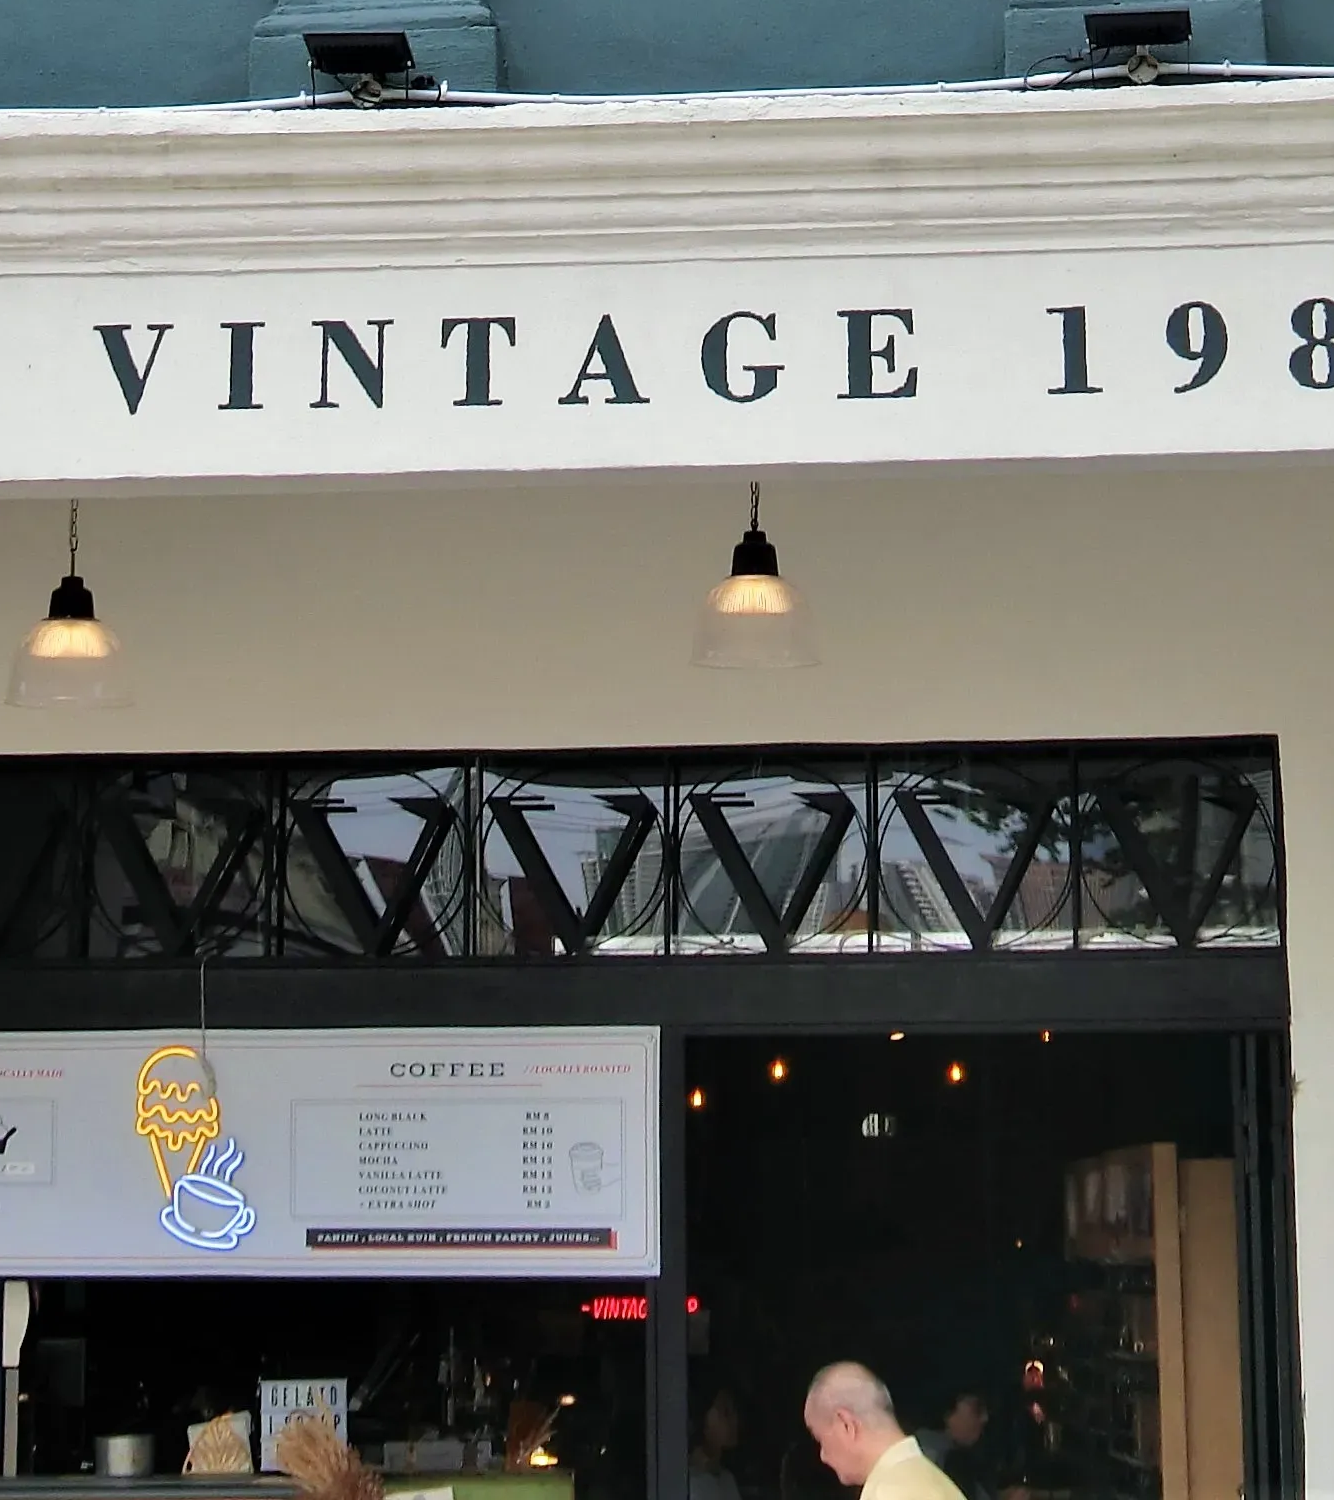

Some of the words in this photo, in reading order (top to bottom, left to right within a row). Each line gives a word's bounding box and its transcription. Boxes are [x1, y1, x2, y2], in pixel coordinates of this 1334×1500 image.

[94, 307, 920, 415] VINTAGE
[389, 1062, 506, 1078] COFFEE
[358, 1112, 389, 1121] LONG
[391, 1112, 428, 1121] BLACK
[358, 1127, 393, 1136] LATTE
[358, 1141, 429, 1151] CAPPUCCINO
[358, 1156, 398, 1165] MOCHA
[408, 1171, 443, 1180] LATTE
